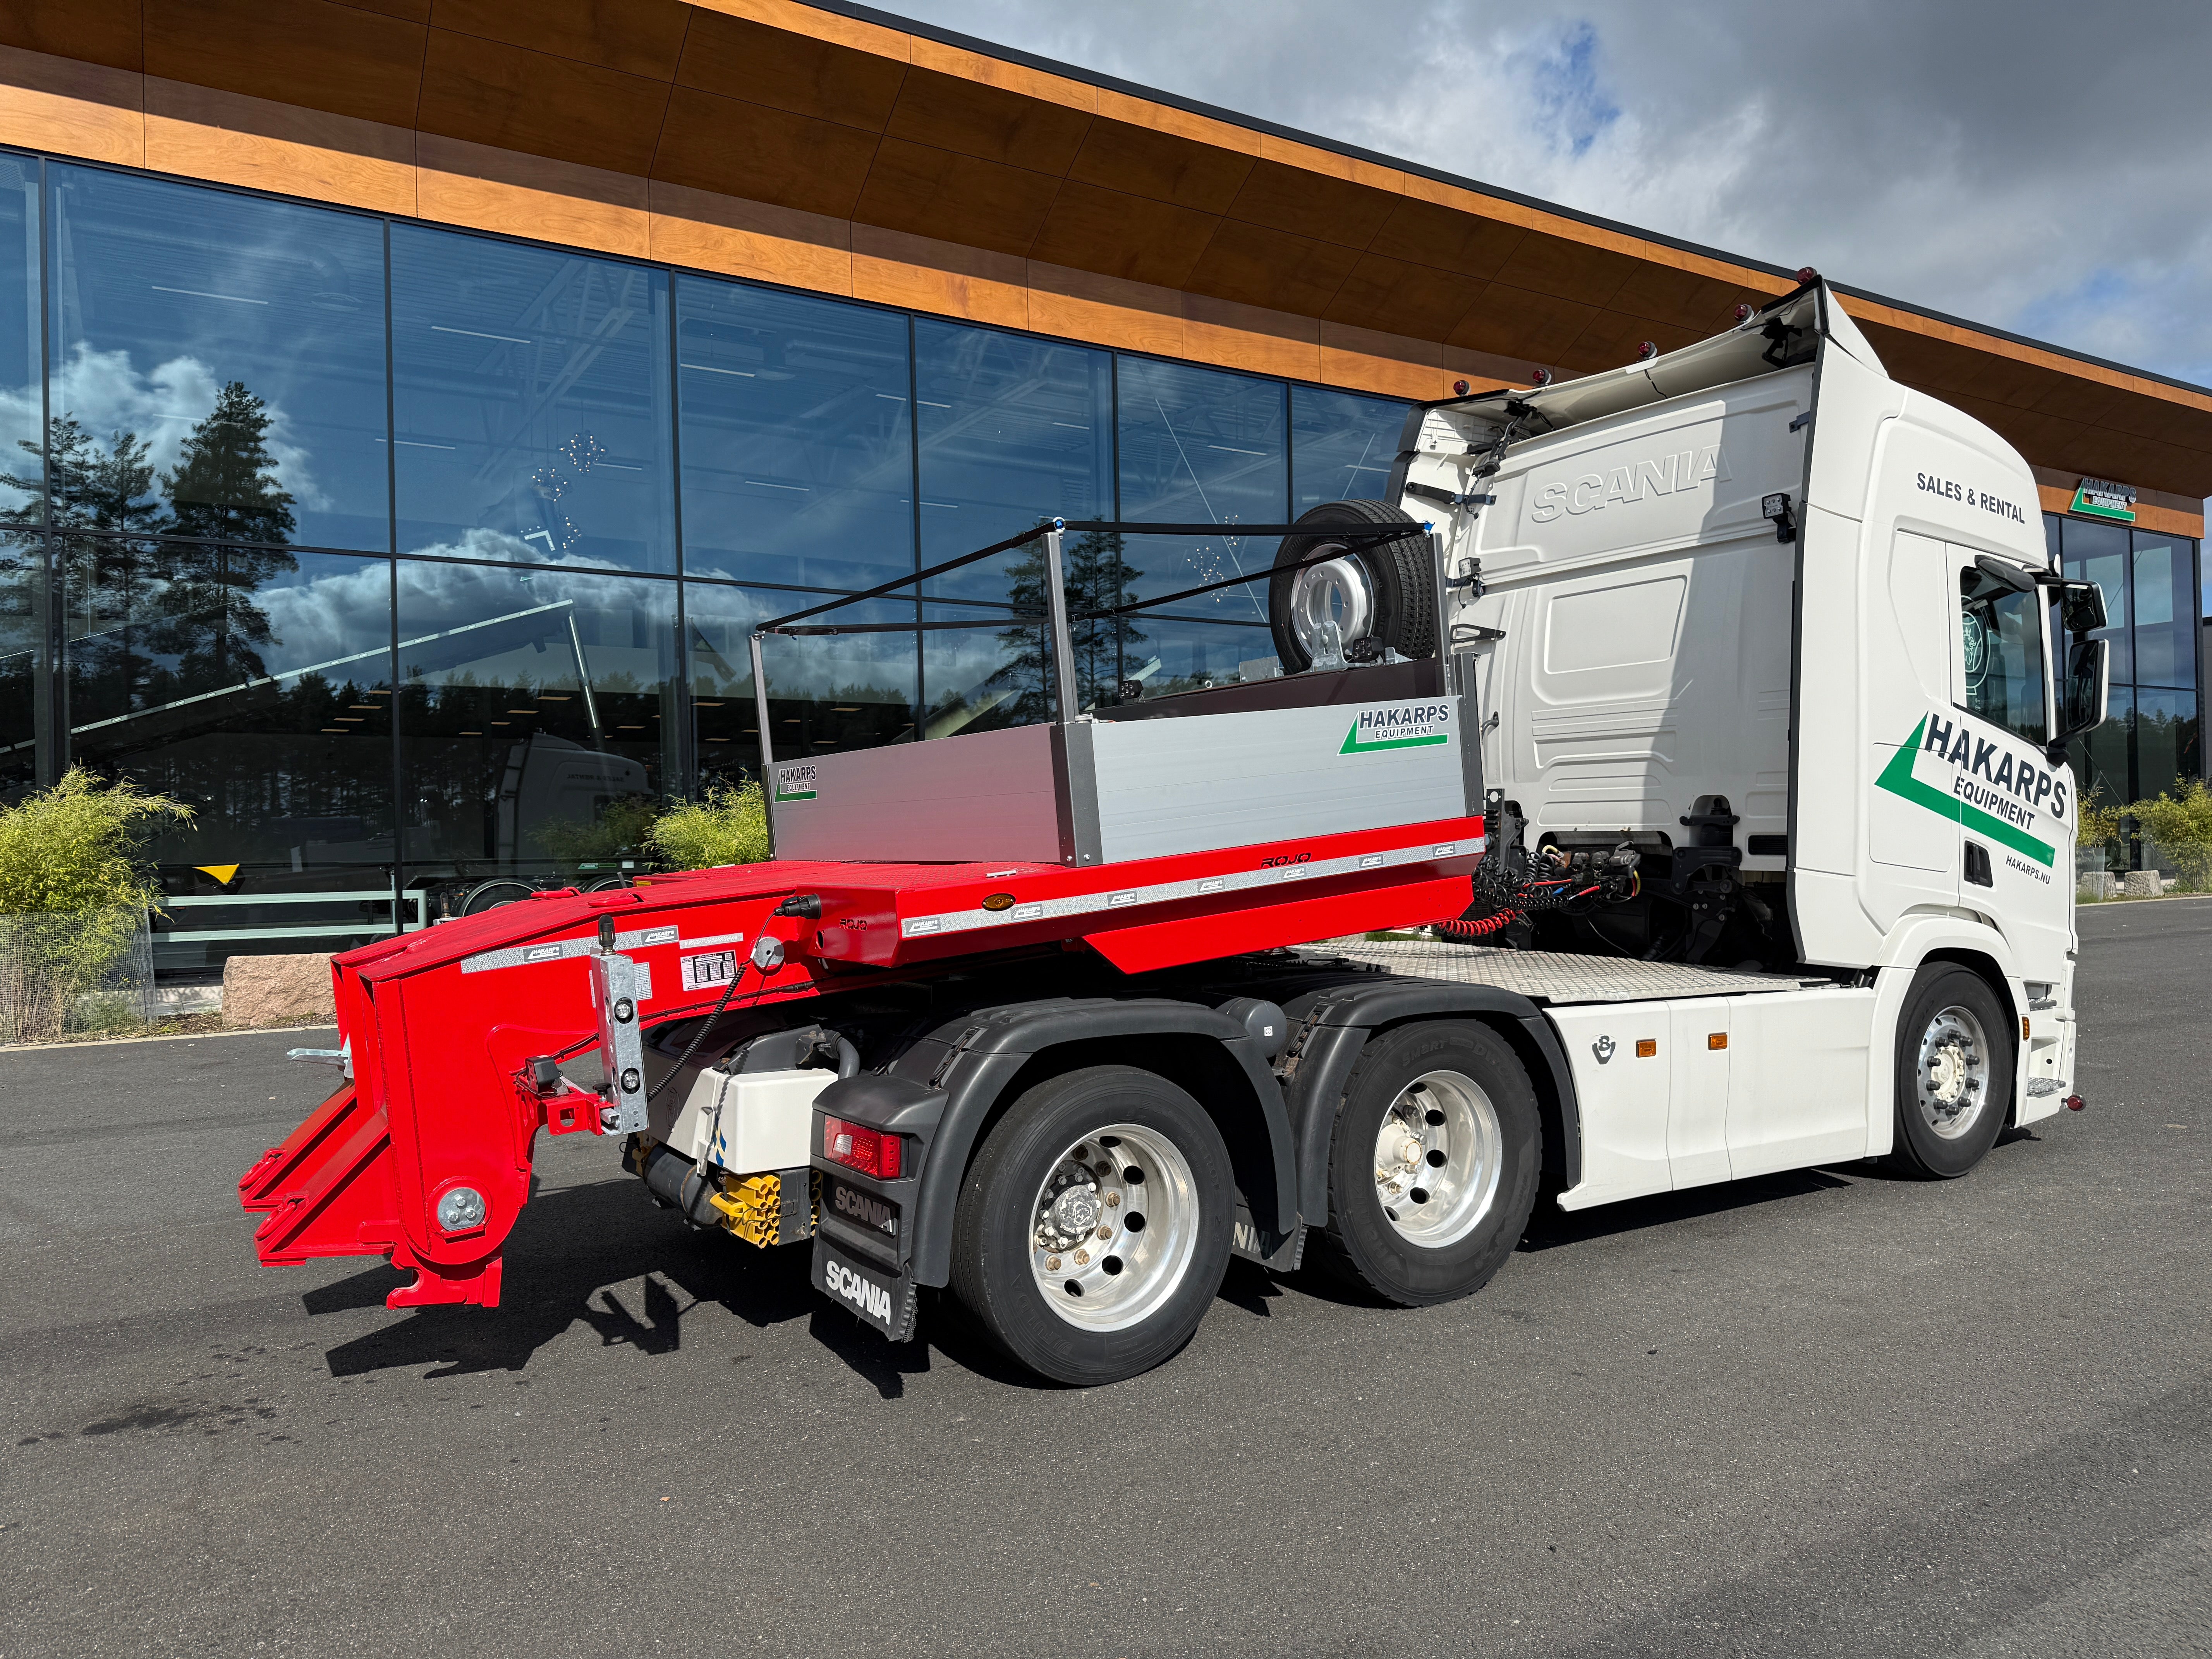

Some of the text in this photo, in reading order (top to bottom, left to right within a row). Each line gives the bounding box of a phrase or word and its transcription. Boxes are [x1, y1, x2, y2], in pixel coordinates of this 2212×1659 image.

[1531, 444, 1732, 523] SCANIA
[2084, 478, 2136, 503] HAKARPS
[1917, 472, 2025, 524] SALES & RENTAL
[2092, 496, 2127, 510] EQUIPMENT
[1360, 704, 1449, 729] HAKARPS
[1376, 726, 1433, 738] EQUIPMENT
[780, 765, 816, 783] HAKARPS
[1925, 713, 2066, 819] HAKARPS
[787, 782, 810, 792] EQUIPMENT
[1953, 776, 2035, 830] EQUIPMENT
[1261, 852, 1312, 868] ROJO
[2006, 855, 2051, 884] HAKARPS.NU
[839, 918, 867, 931] ROJO
[835, 1186, 897, 1236] SCANIA
[826, 1261, 891, 1325] SCANIA
[1011, 1274, 1060, 1345] FULDA
